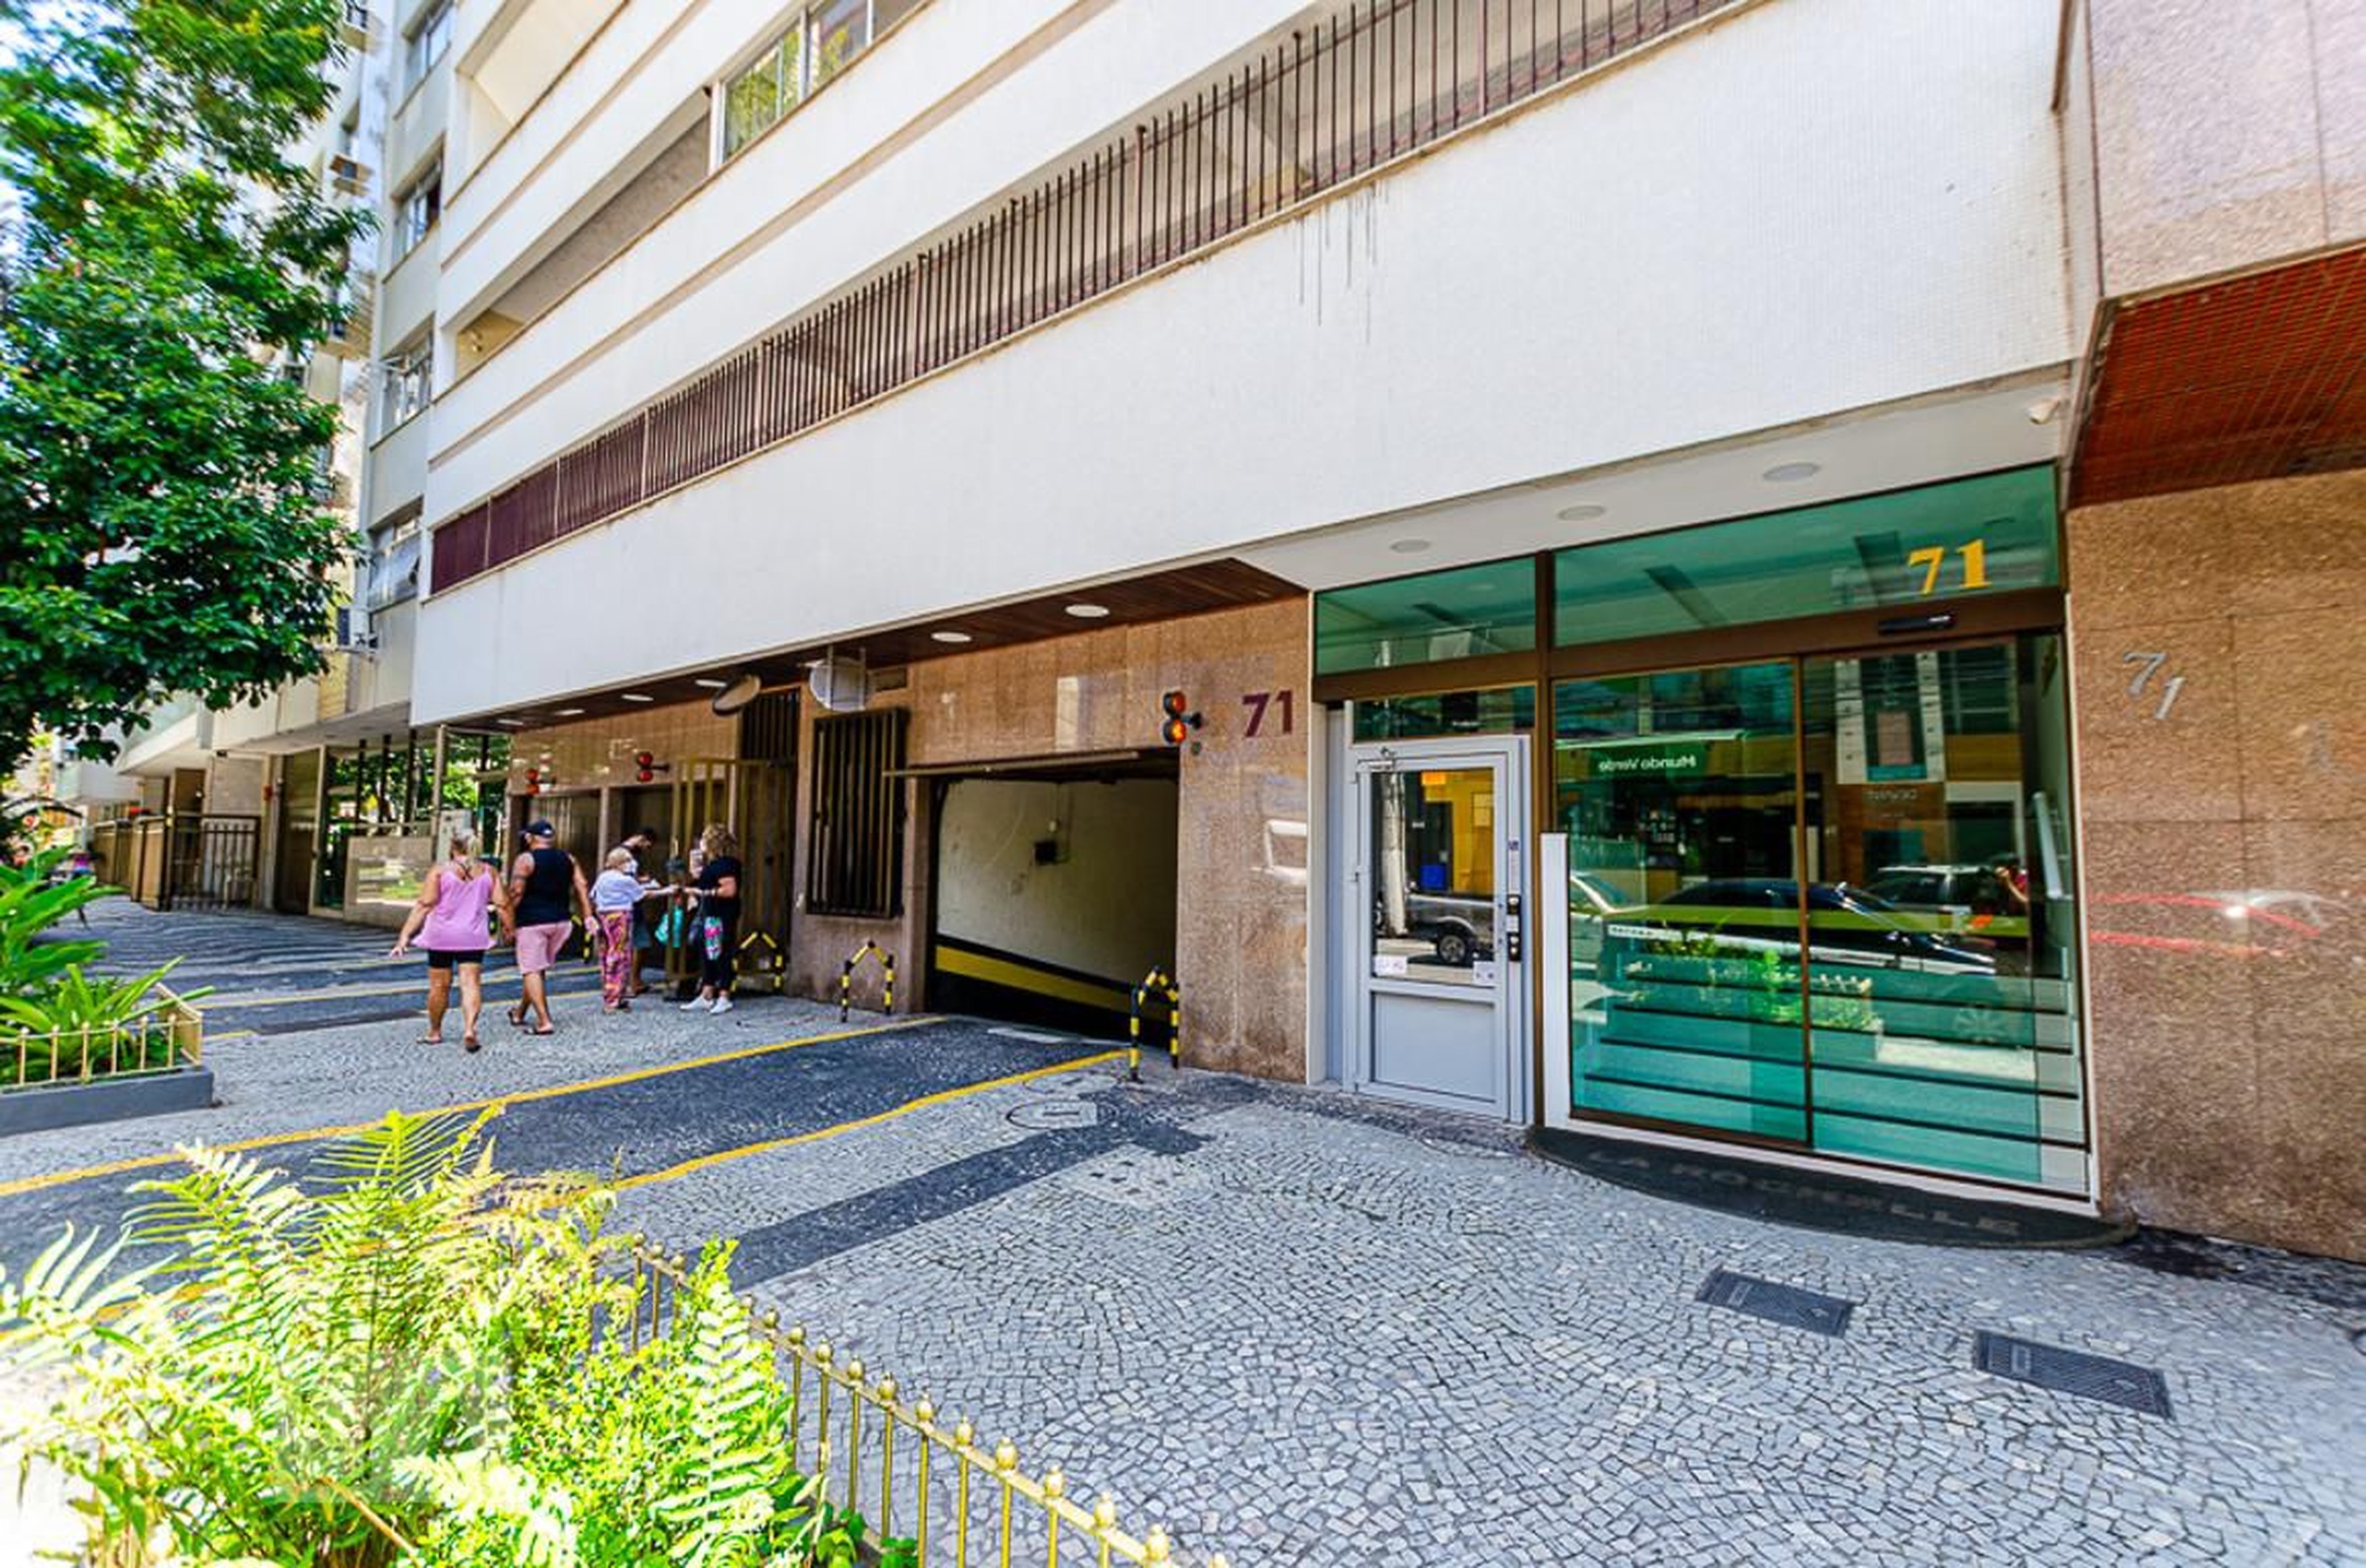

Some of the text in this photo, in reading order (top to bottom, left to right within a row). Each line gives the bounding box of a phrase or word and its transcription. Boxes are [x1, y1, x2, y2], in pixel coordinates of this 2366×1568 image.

[1908, 538, 1993, 595] 71
[1242, 689, 1293, 737] 71
[2122, 651, 2186, 720] 71
